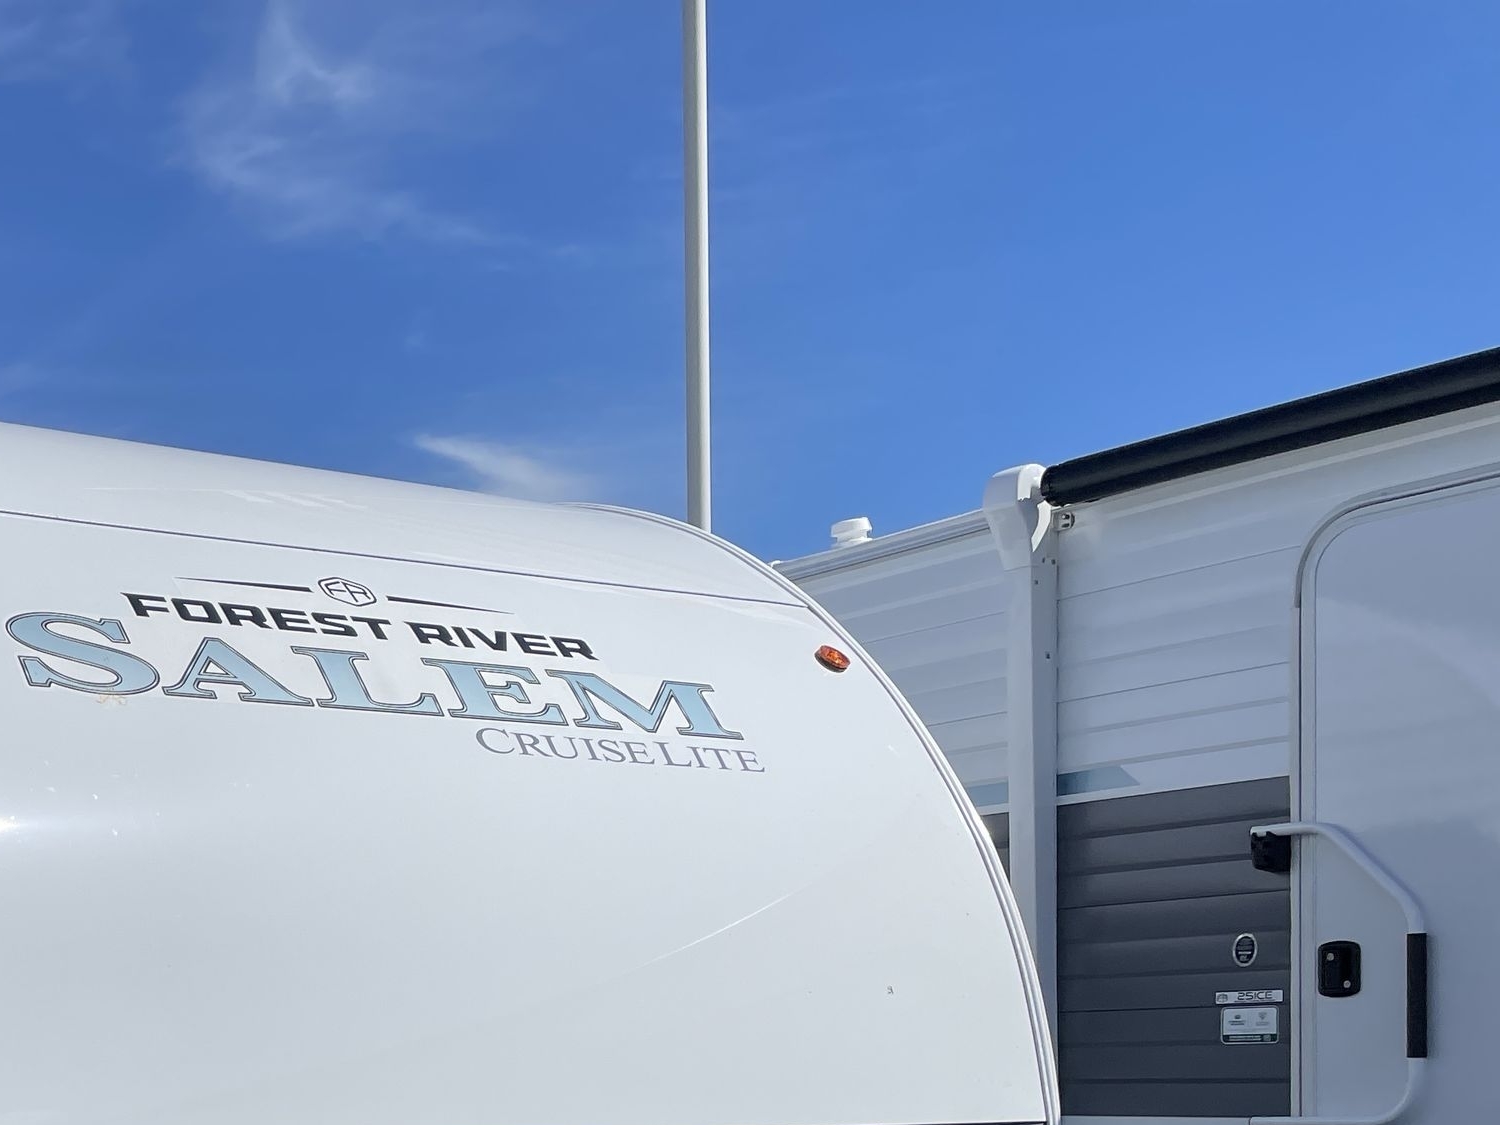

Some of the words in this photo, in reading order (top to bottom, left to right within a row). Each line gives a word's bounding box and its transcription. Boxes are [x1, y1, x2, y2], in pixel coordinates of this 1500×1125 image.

[5, 611, 744, 740] SALEM
[120, 592, 392, 641] FOREST
[404, 621, 600, 661] RIVER
